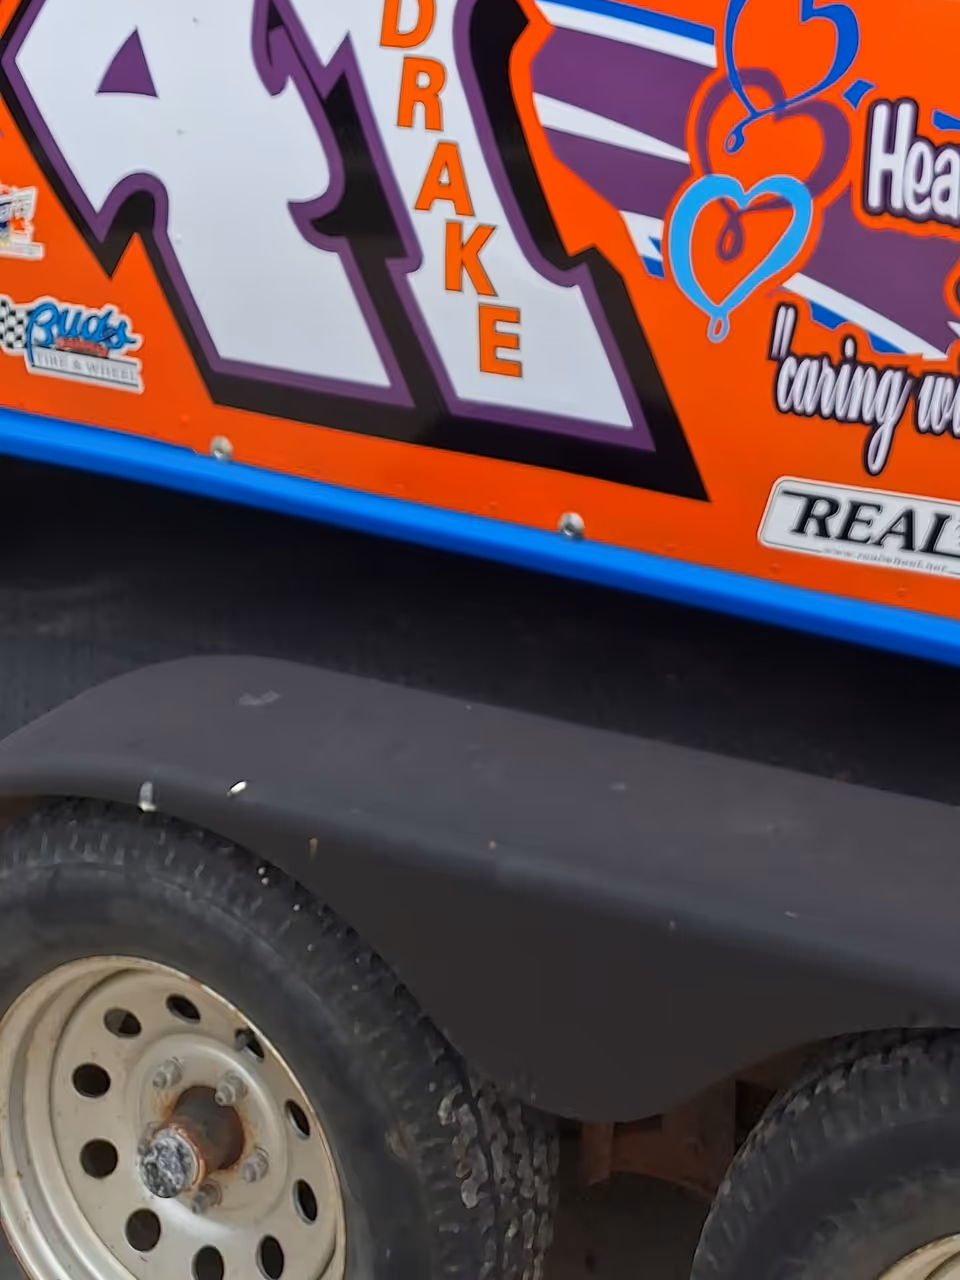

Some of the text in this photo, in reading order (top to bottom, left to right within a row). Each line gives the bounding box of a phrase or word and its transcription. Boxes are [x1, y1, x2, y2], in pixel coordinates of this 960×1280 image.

[36, 352, 68, 369] TIRE
[86, 361, 136, 382] WHEEL
[769, 303, 914, 475] "caring
[788, 492, 952, 555] REAL
